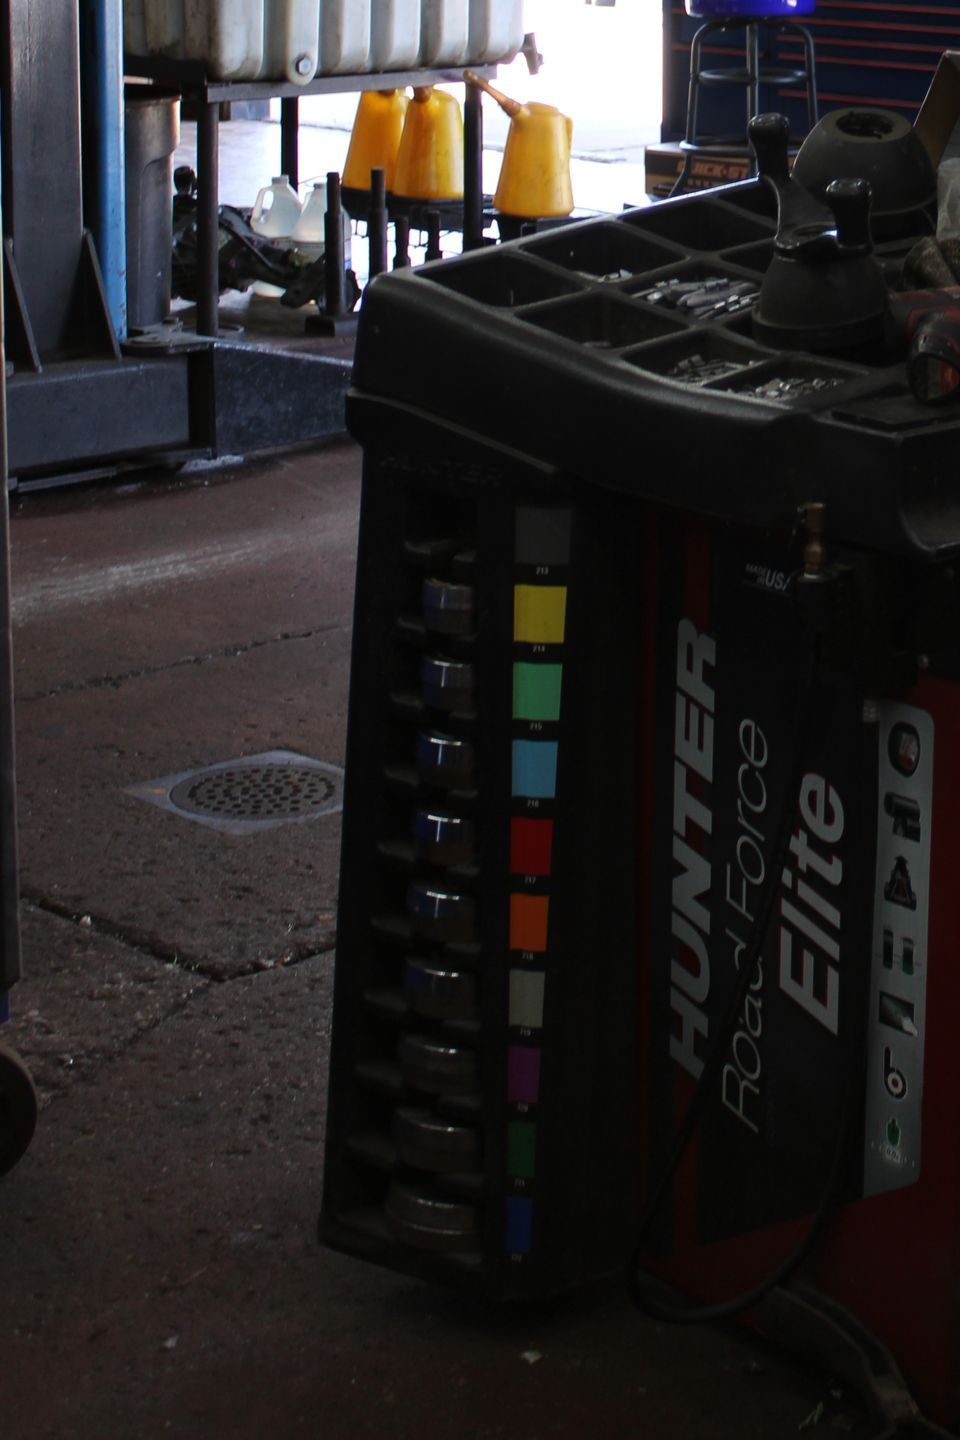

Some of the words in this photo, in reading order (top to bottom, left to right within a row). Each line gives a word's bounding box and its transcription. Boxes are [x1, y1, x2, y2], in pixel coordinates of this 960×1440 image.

[668, 617, 717, 1081] HUNTER
[725, 717, 769, 923] Force
[778, 772, 845, 1037] Elite
[722, 927, 766, 1134] Road
